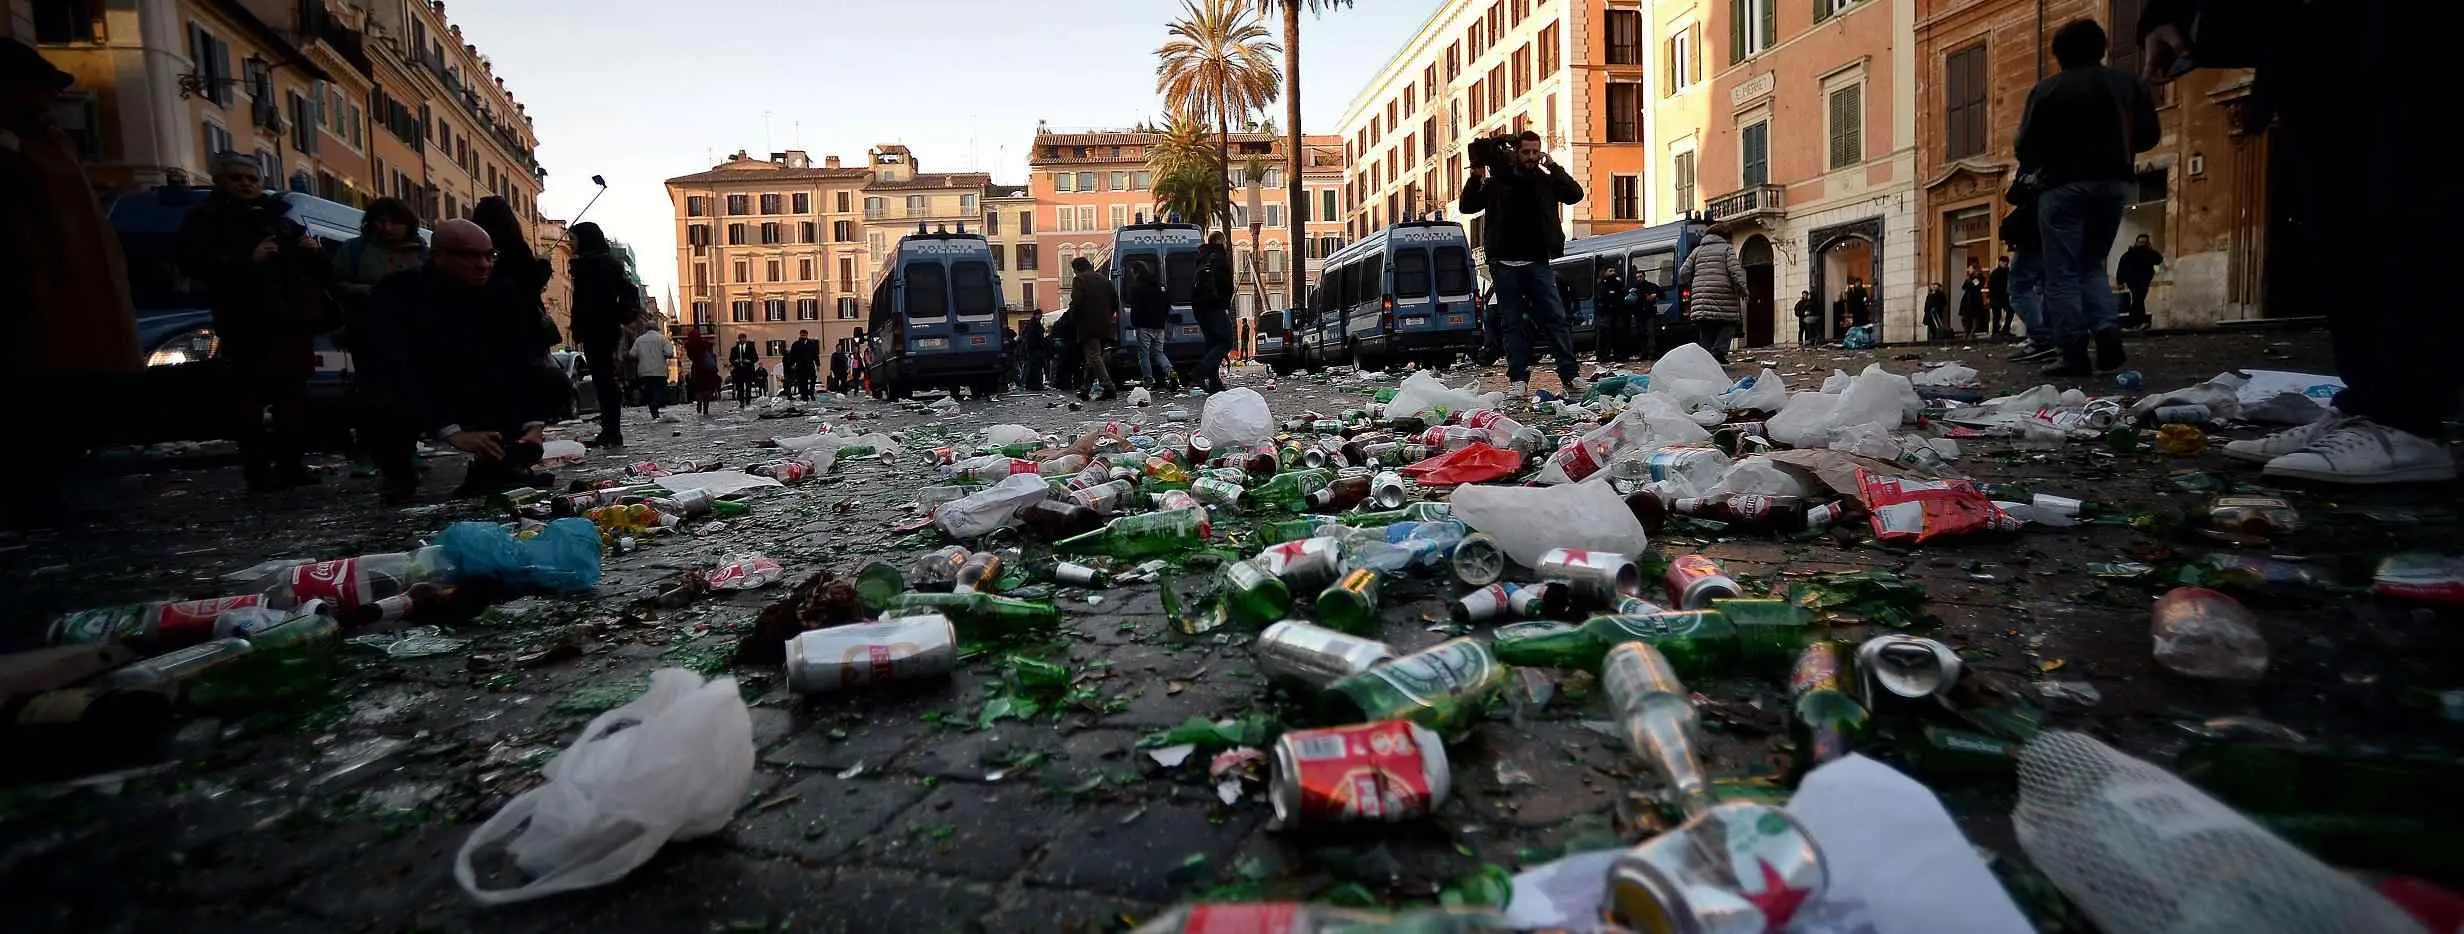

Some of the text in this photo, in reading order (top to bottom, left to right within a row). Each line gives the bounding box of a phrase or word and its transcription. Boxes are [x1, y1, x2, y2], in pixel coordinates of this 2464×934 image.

[1134, 235, 1190, 245] POLIZIA
[1405, 232, 1454, 241] POLIZIA
[918, 245, 976, 255] POLIZIA
